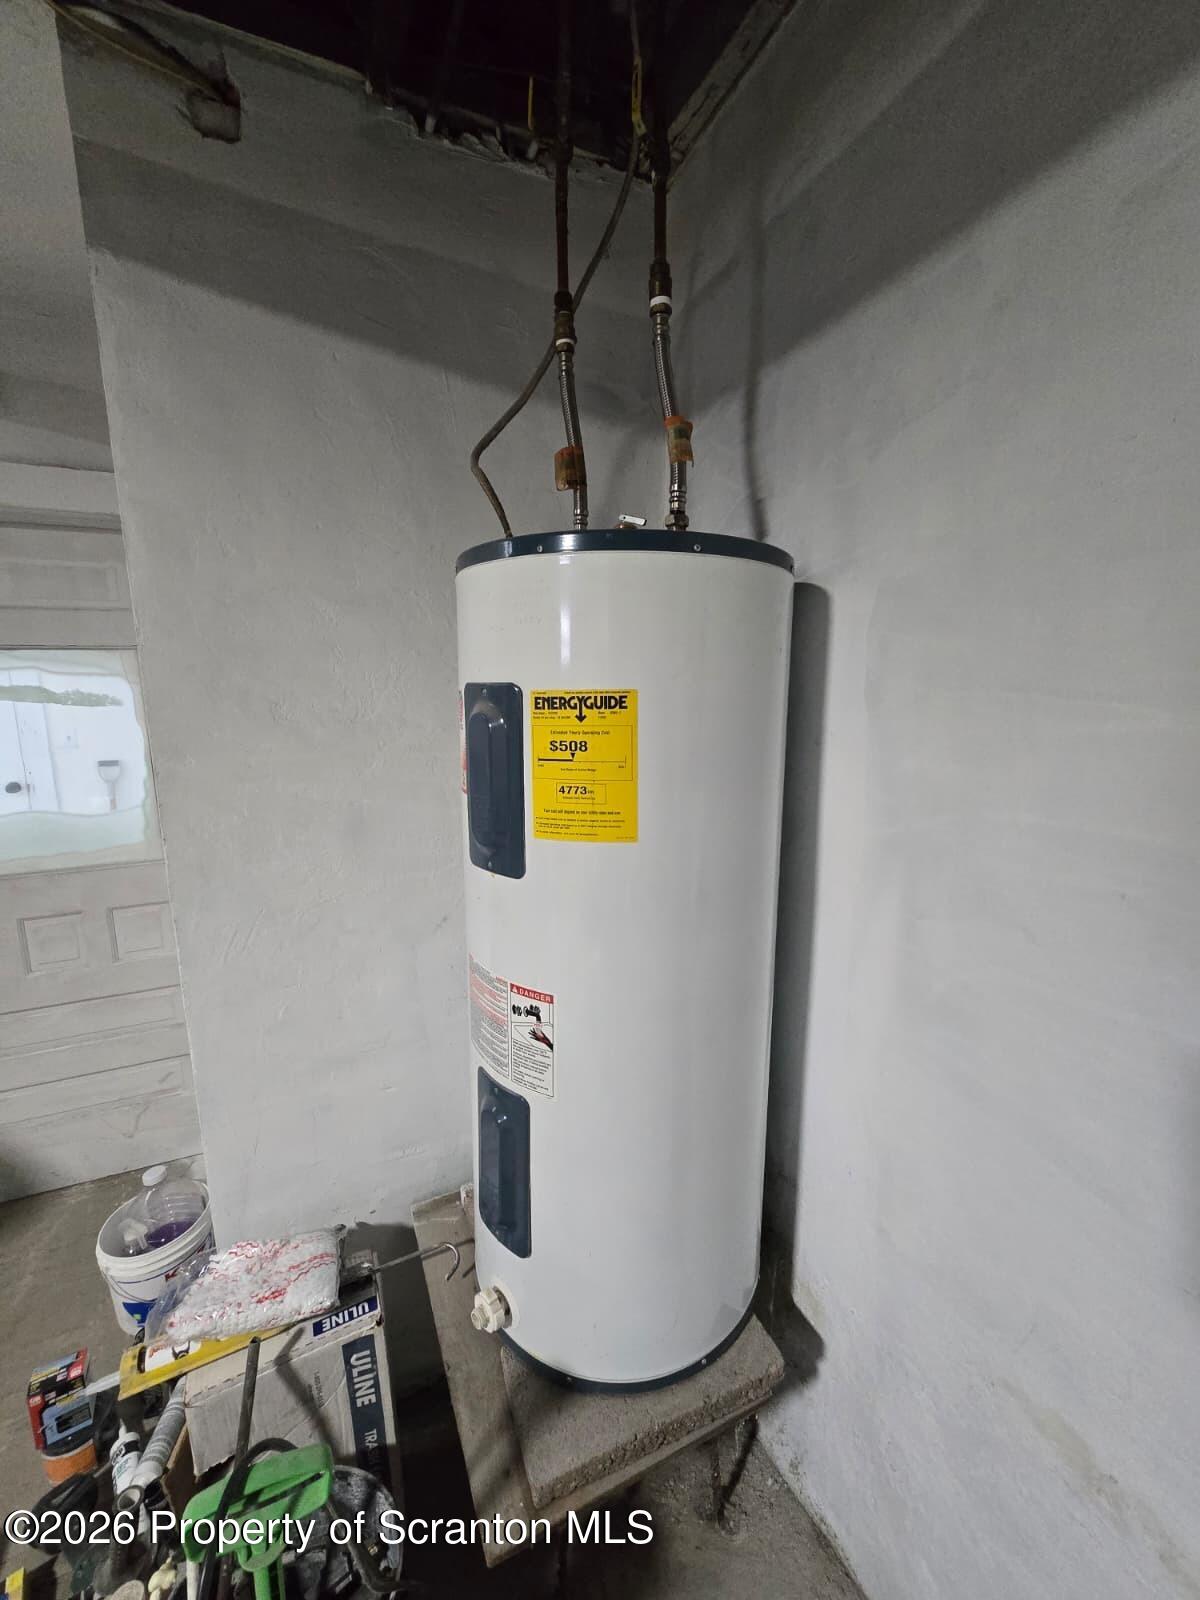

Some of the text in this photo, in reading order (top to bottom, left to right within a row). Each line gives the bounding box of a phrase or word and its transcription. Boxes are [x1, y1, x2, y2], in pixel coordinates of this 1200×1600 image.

[534, 695, 628, 711] ENERGYGUIDE
[549, 740, 588, 752] $508
[558, 785, 587, 795] 4773
[519, 988, 552, 1003] DANGER
[321, 1301, 370, 1332] ULINE
[350, 1350, 377, 1408] ULINE
